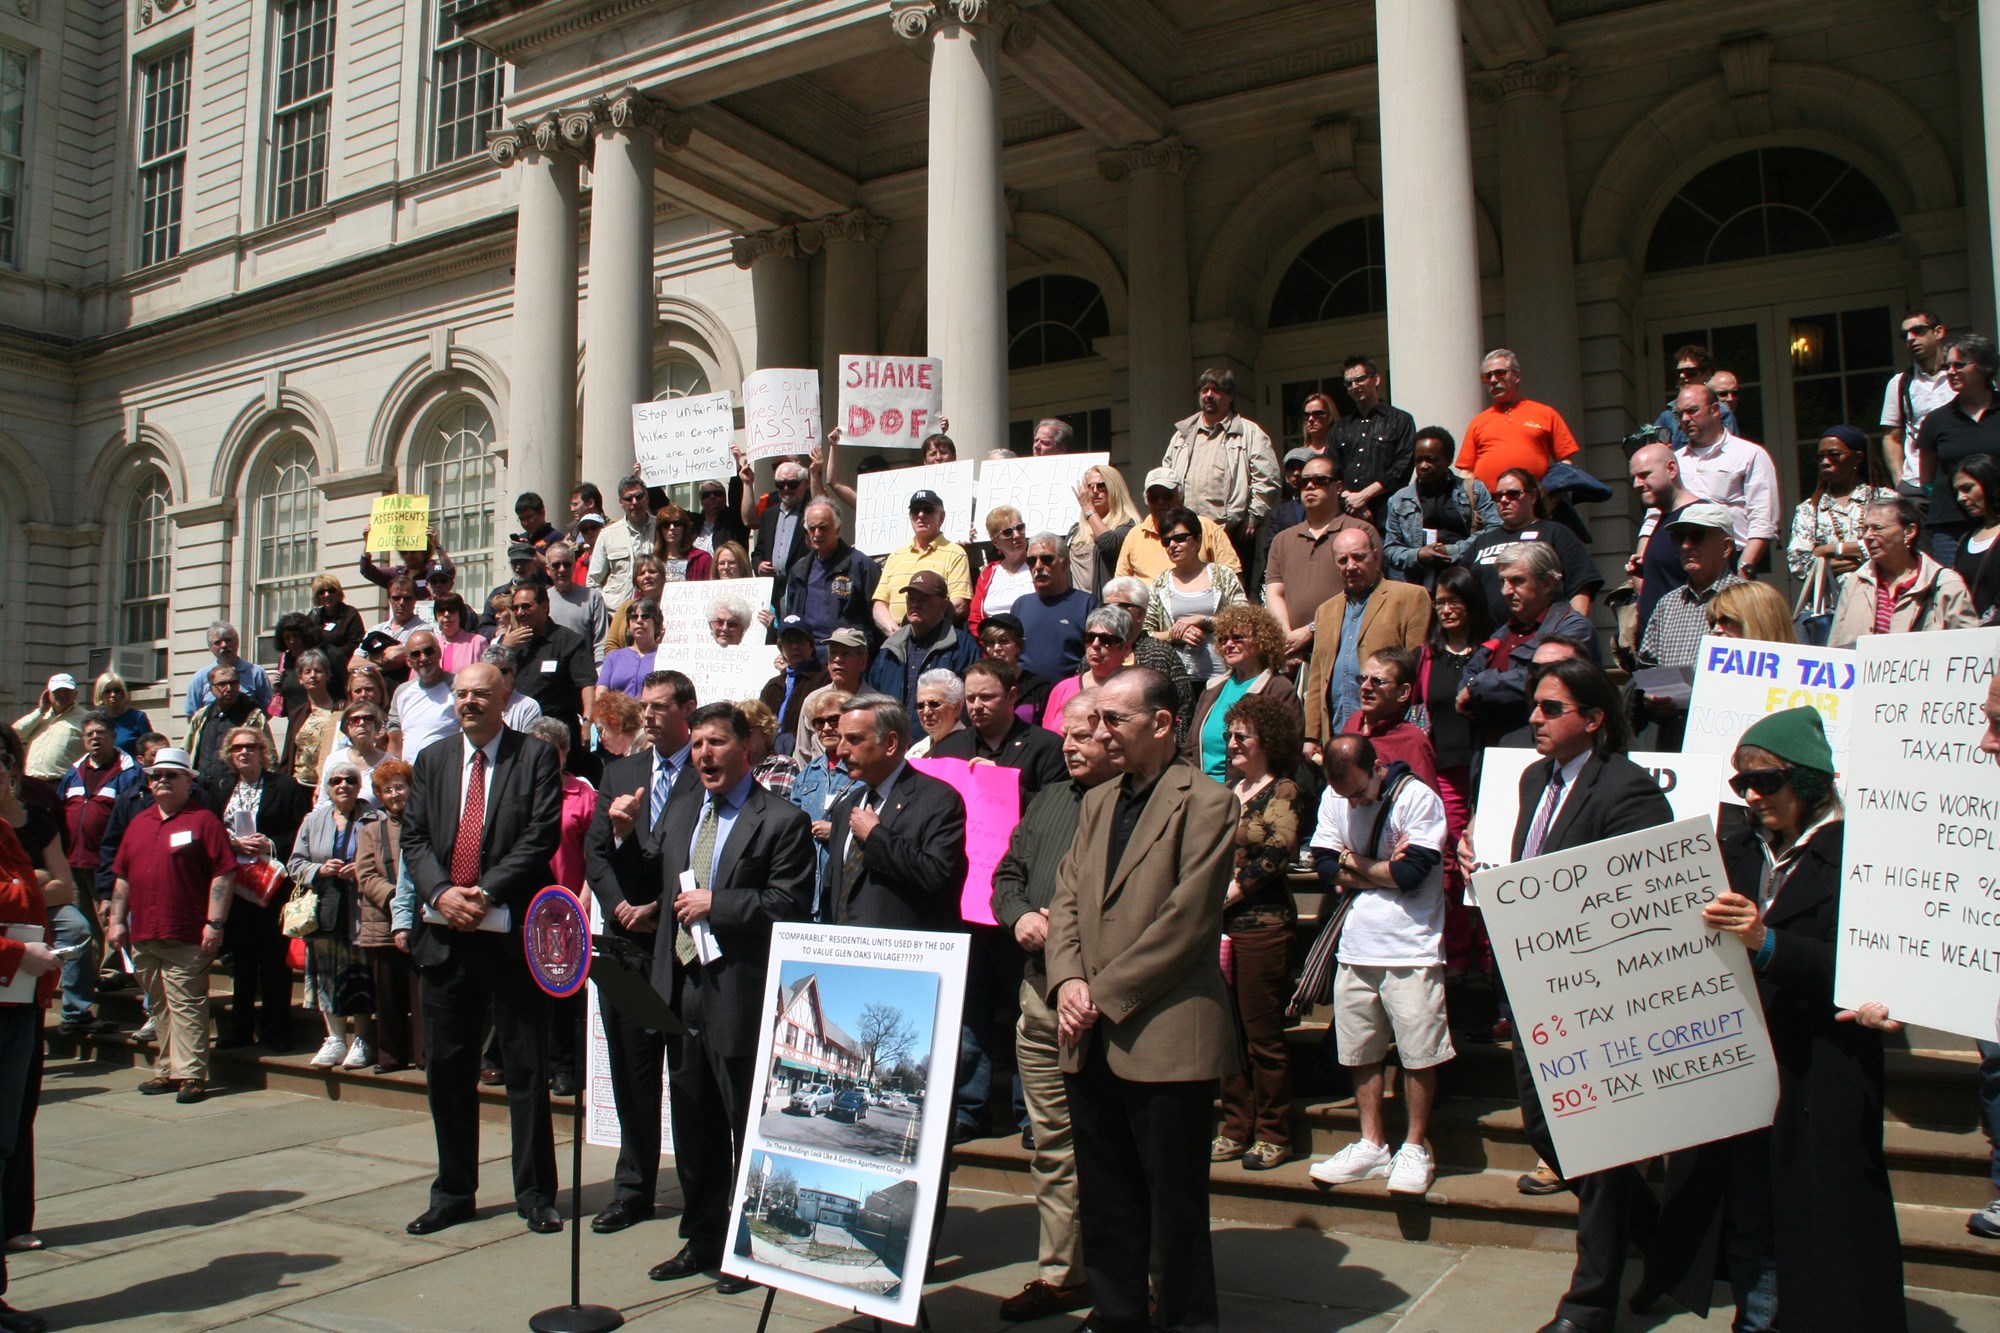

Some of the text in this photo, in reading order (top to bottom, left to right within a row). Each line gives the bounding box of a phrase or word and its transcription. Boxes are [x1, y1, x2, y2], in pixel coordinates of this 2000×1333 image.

[782, 380, 813, 392] our
[846, 361, 934, 390] SHAME
[638, 397, 730, 423] Stop unfair Tax
[848, 404, 928, 438] DOF
[638, 430, 668, 444] hikes
[638, 454, 658, 463] We
[666, 449, 684, 458] are
[643, 465, 680, 479] Family
[860, 463, 958, 494] TAX THE
[986, 462, 1031, 484] TAX
[383, 497, 412, 510] FAIR
[988, 482, 1061, 510] FREE
[373, 511, 425, 525] ASSESSMENTS
[389, 525, 405, 534] FOR
[378, 536, 419, 547] QUEENS!
[664, 583, 759, 600] CZAR BLOOMBERG
[664, 620, 687, 630] NEAK
[659, 648, 751, 661] CZAR BLOOMBERG
[1707, 647, 1780, 679] FAIR
[695, 662, 743, 673] TARGETS
[1863, 659, 1930, 685] IMPEACH
[724, 687, 737, 697] OF
[1765, 687, 1840, 720] FOR
[1874, 704, 1908, 724] FOR
[1858, 788, 1927, 812] TAXING
[1938, 824, 2000, 850] PEOPL
[1497, 834, 1712, 904] CO-OP OWNERS
[1850, 864, 1873, 883] AT
[1885, 866, 1960, 893] HIGHER
[1580, 866, 1711, 913] ARE SMALL
[1924, 901, 1950, 918] OF
[1515, 886, 1715, 961] HOME OWNERS
[778, 932, 955, 951] "COMPARABLE" RESIDENTIAL UNITS USED BY THE DOF
[802, 946, 812, 954] TO
[813, 947, 833, 957] VALUE
[835, 949, 852, 958] GLEN
[853, 950, 872, 959] OAKS
[1849, 928, 1890, 950] THAN
[1898, 935, 1930, 957] THE
[1546, 932, 1722, 994] THUS, MAXIMUM
[1532, 973, 1734, 1045] 6% TAX INCREASE
[1539, 1010, 1745, 1081] NOT THE CORRUPT
[1552, 1043, 1755, 1112] 50% TAX INCREASE
[774, 1142, 787, 1151] These
[788, 1144, 810, 1157] Buildings
[810, 1150, 822, 1158] Look
[823, 1152, 833, 1160] Like
[838, 1156, 857, 1165] Garden
[858, 1159, 886, 1171] Apartment
[887, 1165, 905, 1175] Co-op?
